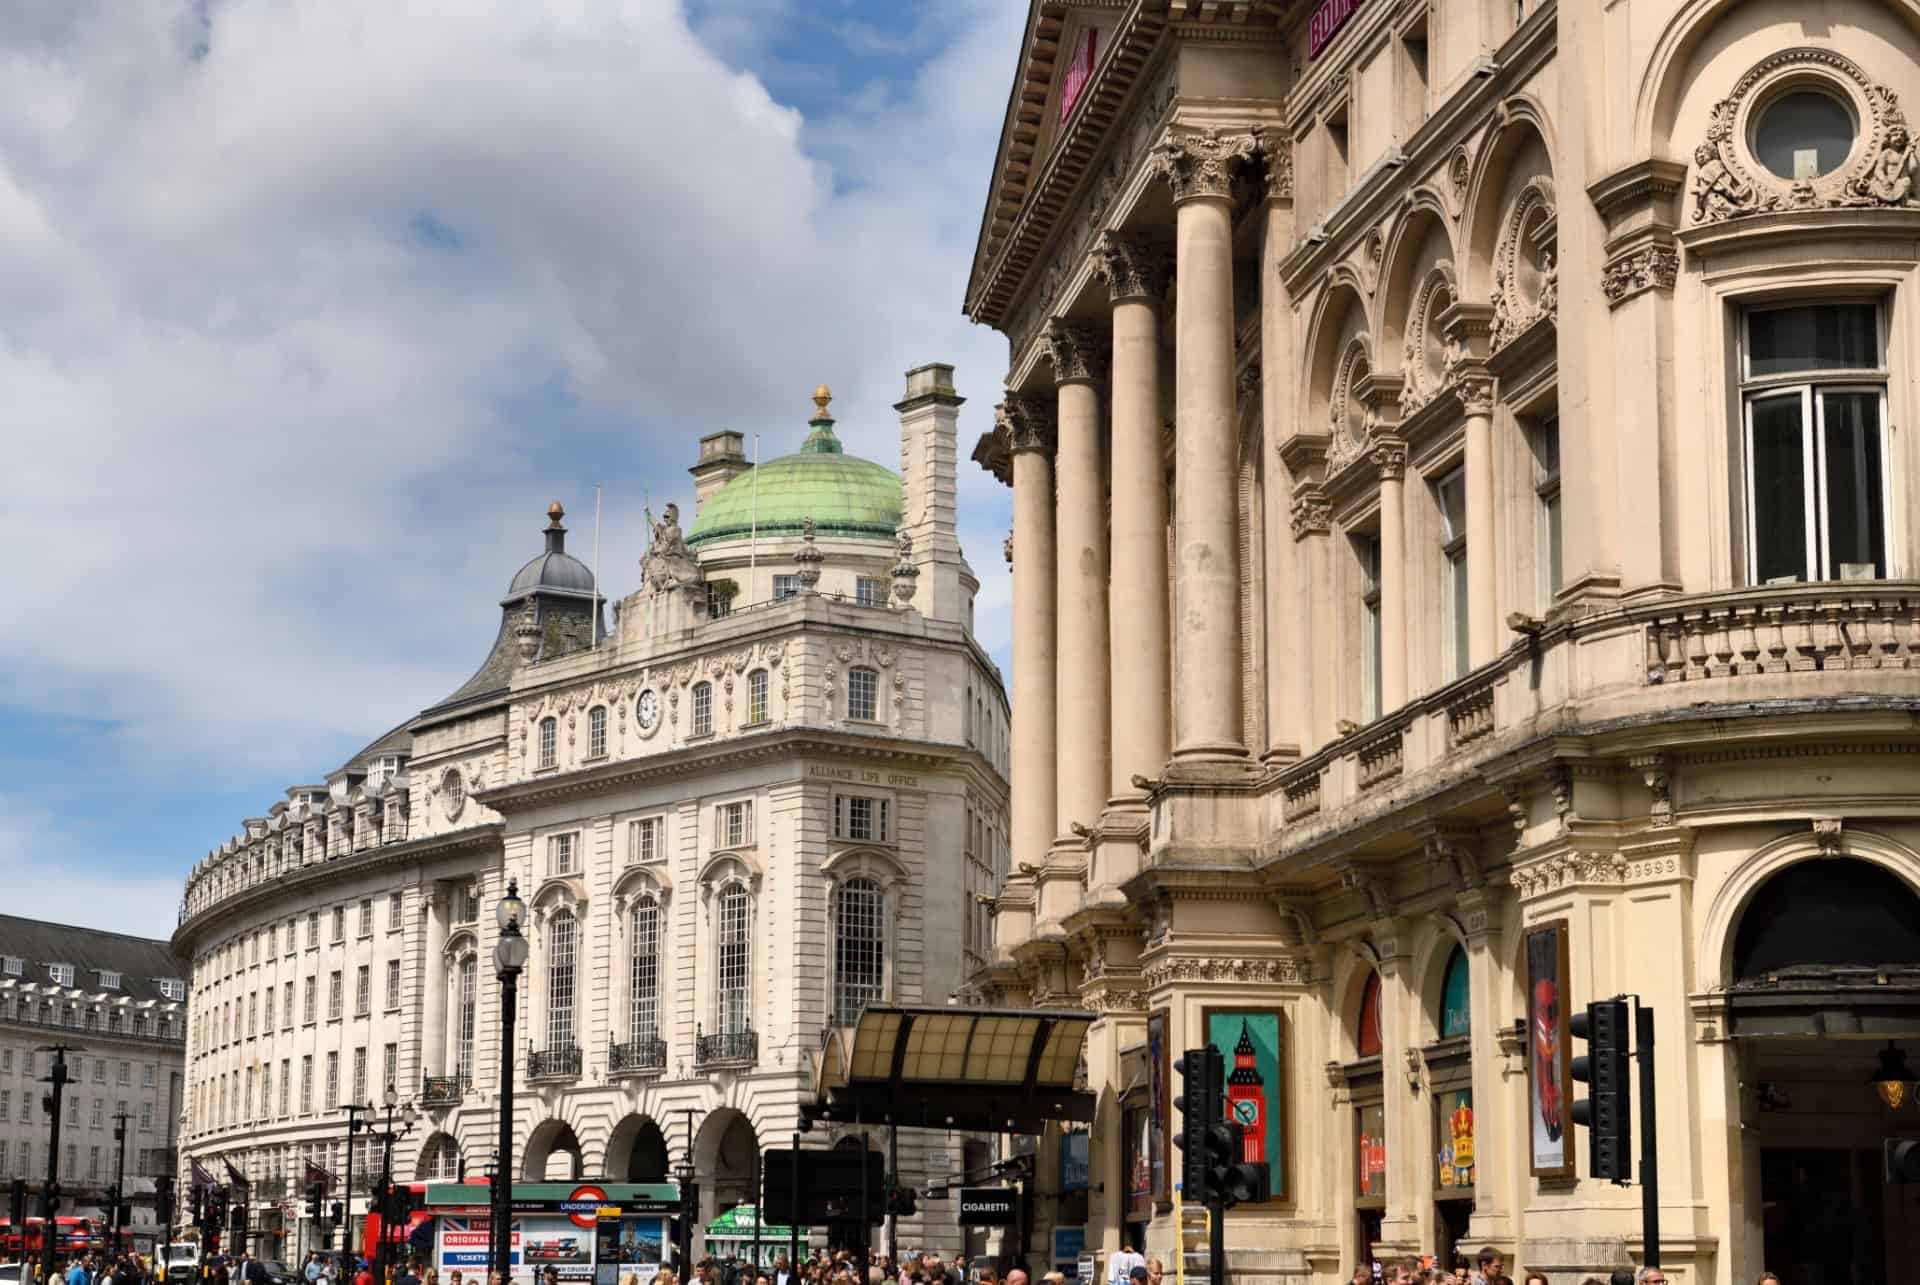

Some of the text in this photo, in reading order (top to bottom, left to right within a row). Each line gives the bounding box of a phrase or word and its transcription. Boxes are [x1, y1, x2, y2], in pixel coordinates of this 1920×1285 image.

[1310, 0, 1352, 57] BOD
[862, 770, 880, 783] LIFE
[888, 775, 918, 787] OFFICE
[456, 1254, 487, 1262] TICKETS
